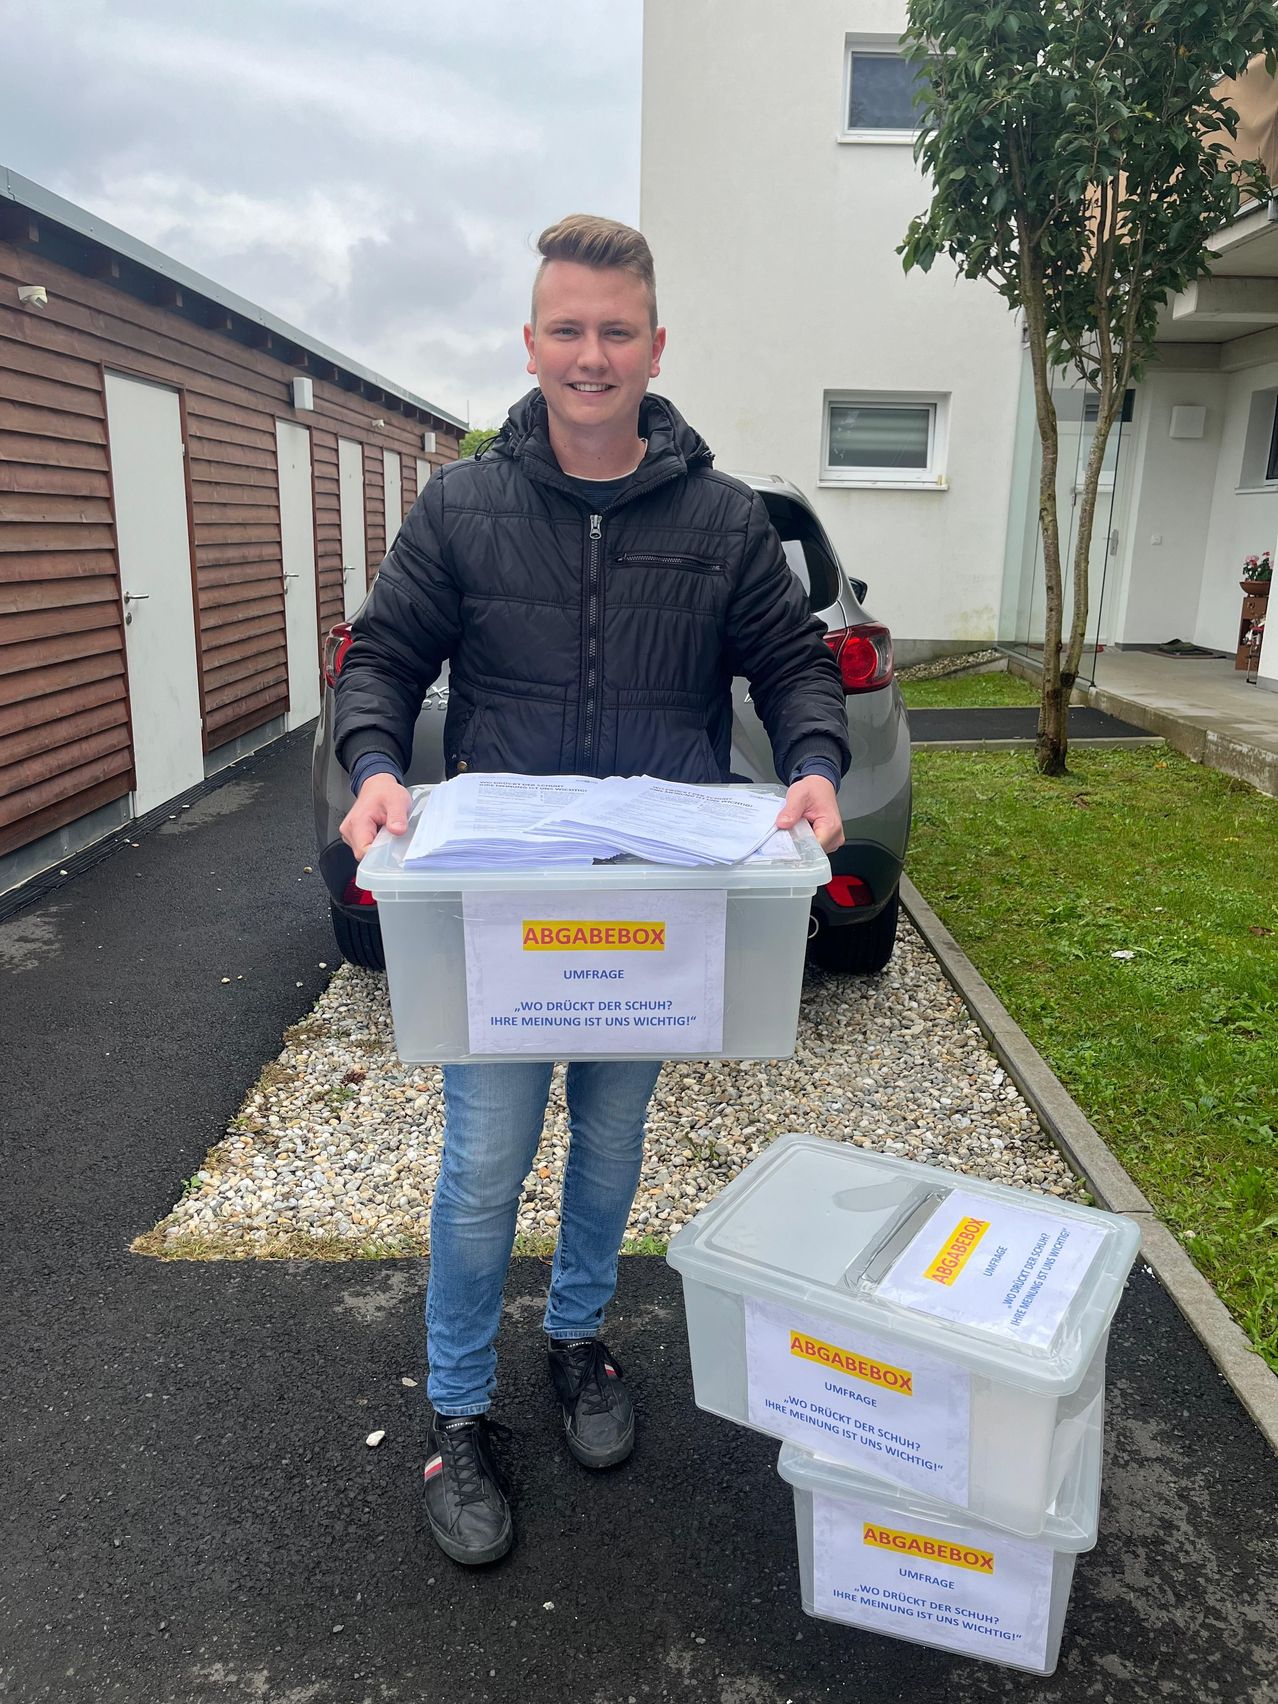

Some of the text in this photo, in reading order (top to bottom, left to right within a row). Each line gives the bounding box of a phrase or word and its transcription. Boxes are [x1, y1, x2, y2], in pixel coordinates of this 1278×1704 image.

[523, 927, 665, 945] ABGABEBOX
[563, 969, 625, 980] UMFRAGE
[547, 999, 595, 1011] DRÜCKT
[598, 1001, 622, 1011] DER
[625, 1000, 673, 1011] SCHUH?
[491, 1016, 518, 1026] IHRE
[521, 1016, 581, 1027] MEINUNG
[585, 1016, 602, 1027] IST
[605, 1016, 630, 1027] UNS
[931, 1218, 986, 1285] ABGABEBOX
[1031, 1232, 1051, 1257] SCHUH?
[983, 1245, 1008, 1277] UMFRAGE
[1024, 1256, 1039, 1270] DER
[1010, 1269, 1031, 1294] DRÜCKT
[1010, 1309, 1026, 1327] IHRE
[1019, 1280, 1044, 1310] MEINUNG
[1036, 1271, 1048, 1281] IST
[1042, 1257, 1056, 1271] UNS
[791, 1337, 912, 1391] ABGABEBOX
[825, 1382, 877, 1407] UMFRAGE
[765, 1399, 787, 1414] IHRE
[790, 1409, 839, 1434] MEINUNG
[843, 1429, 857, 1440] IST
[861, 1436, 882, 1450] UNS
[810, 1404, 851, 1425] DRÜCKT
[855, 1420, 875, 1434] DER
[878, 1429, 920, 1451] SCHUH?
[864, 1528, 993, 1570] ABGABEBOX
[899, 1568, 955, 1589] UMFRAGE
[833, 1589, 857, 1602] IHRE
[860, 1597, 913, 1616] MEINUNG
[917, 1610, 933, 1620] IST
[936, 1614, 959, 1626] UNS
[883, 1590, 927, 1607] DRÜCKT
[930, 1601, 951, 1613] DER
[954, 1608, 999, 1624] SCHUH?
